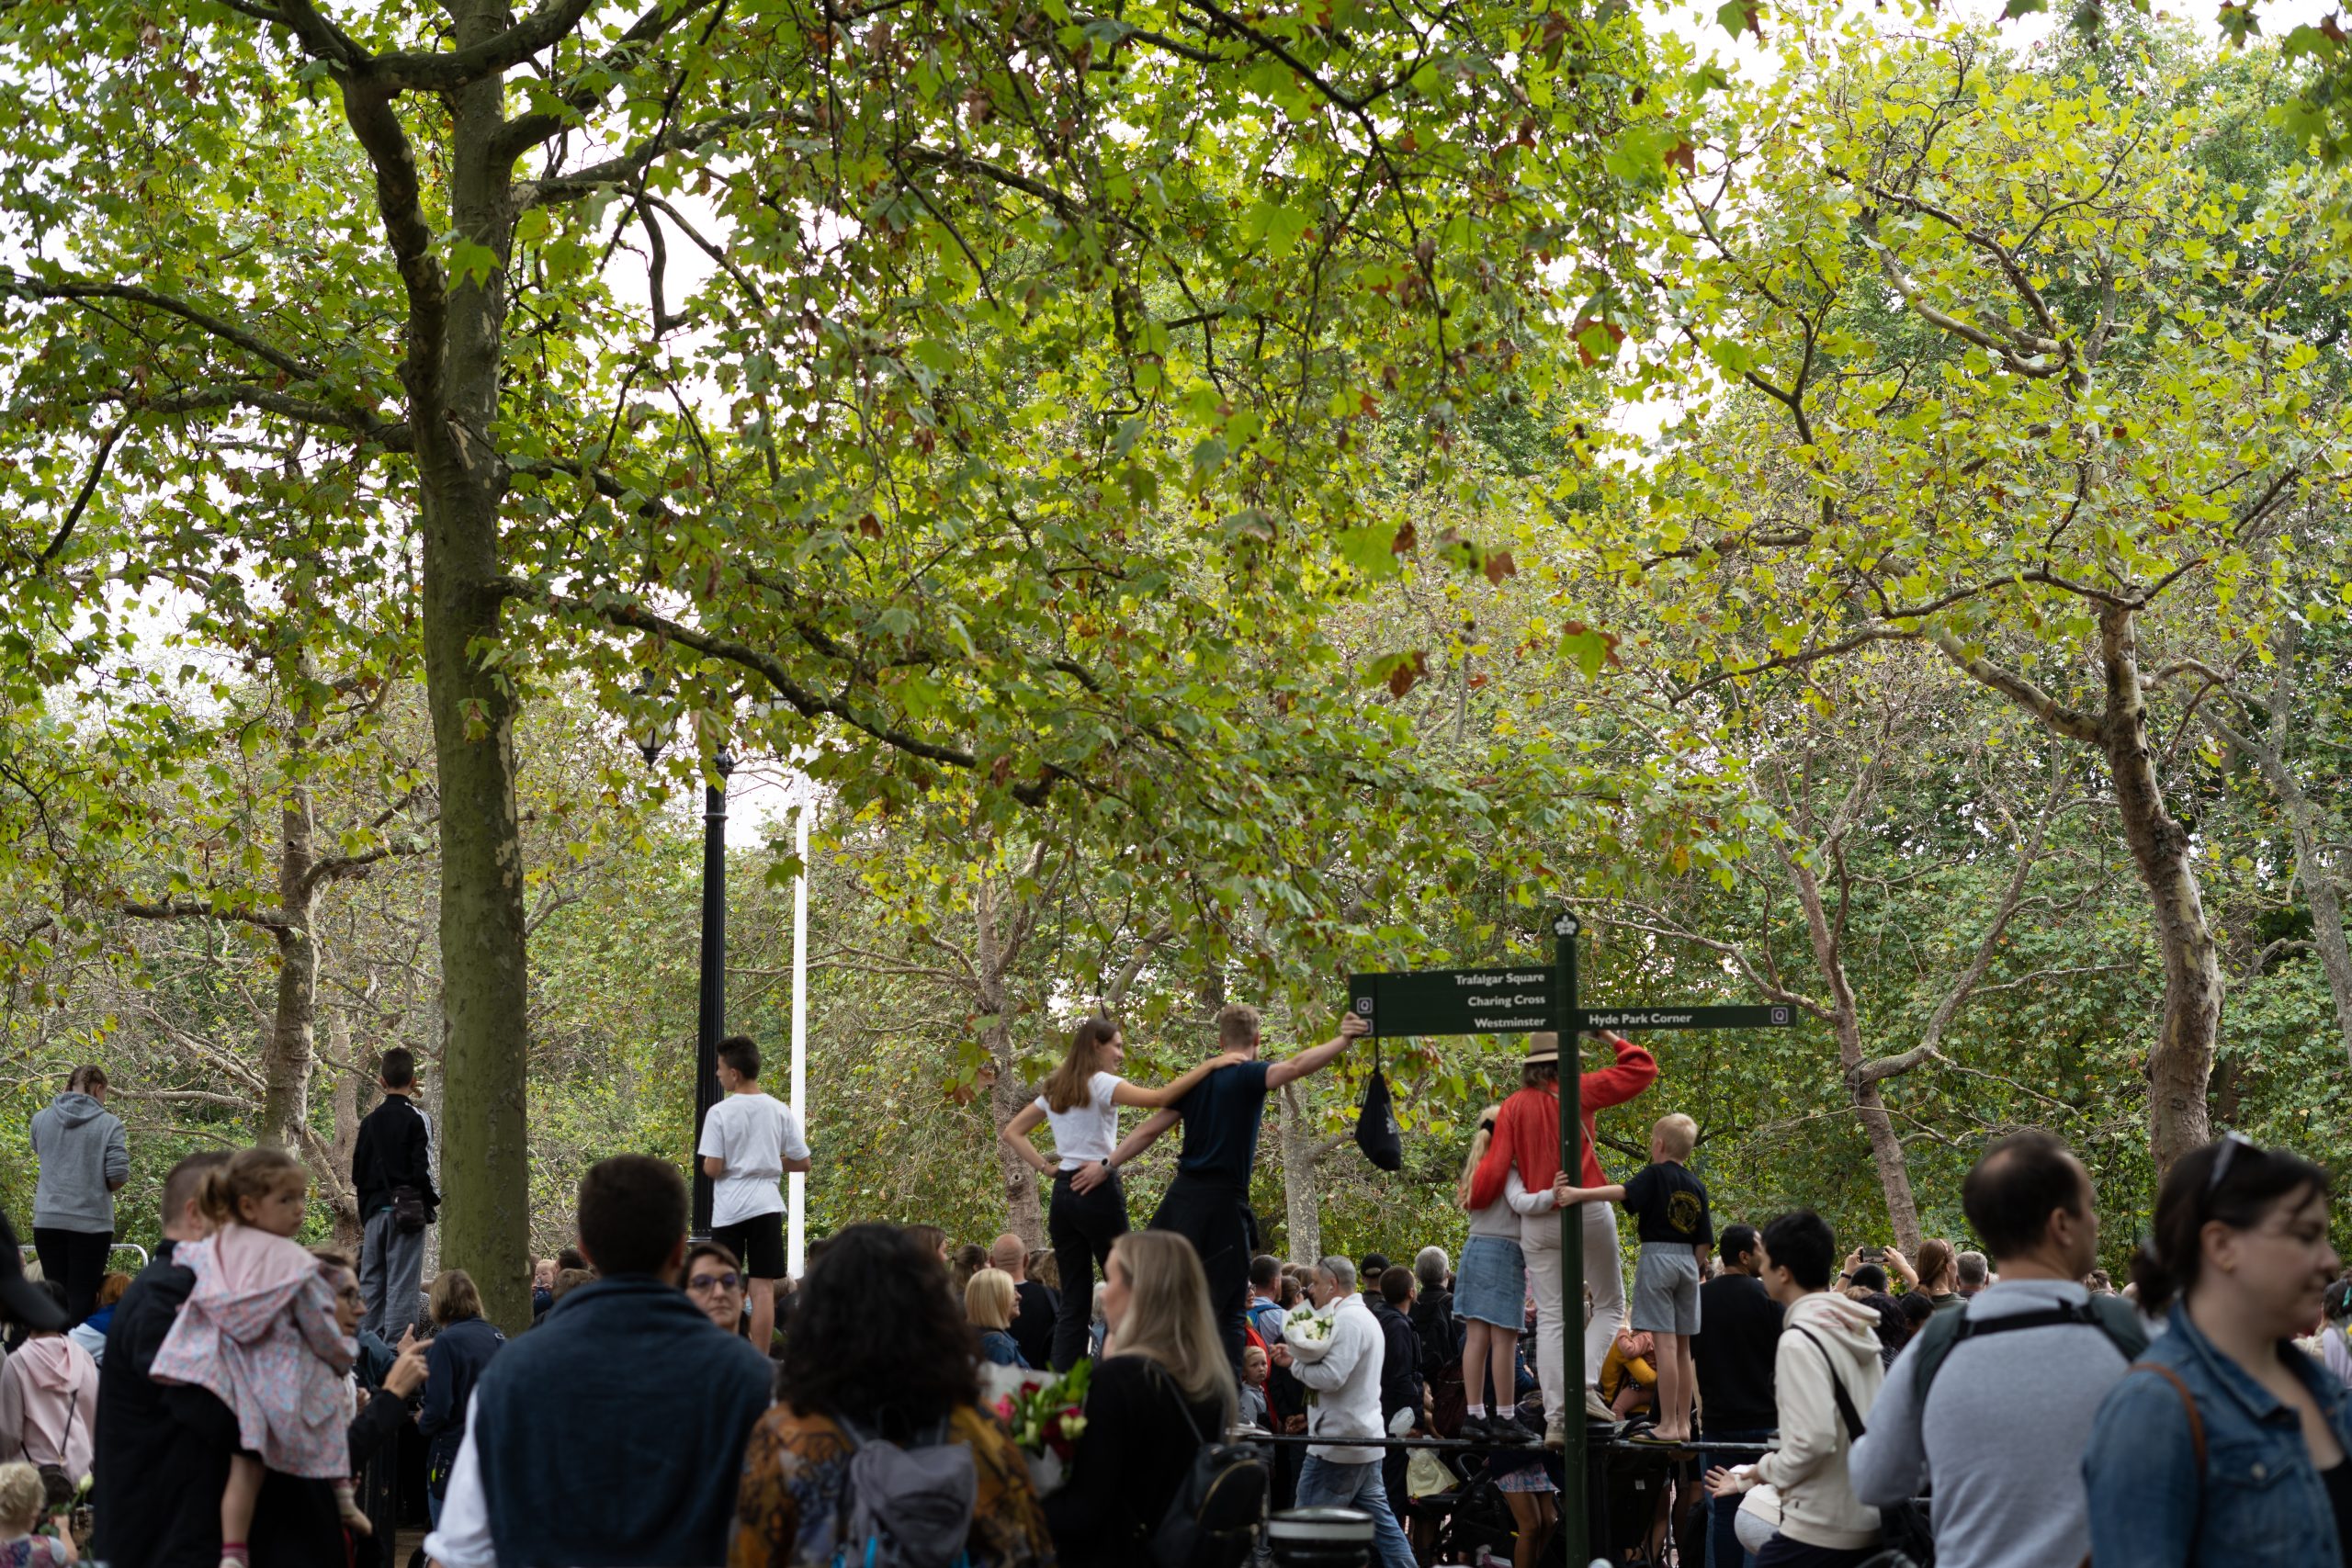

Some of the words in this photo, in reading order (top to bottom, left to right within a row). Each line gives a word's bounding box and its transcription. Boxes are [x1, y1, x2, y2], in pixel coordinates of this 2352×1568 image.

[1454, 975, 1504, 987] Trafalgar
[1506, 973, 1545, 985] Square
[1467, 996, 1512, 1008] Charing
[1514, 995, 1546, 1005] Cross
[1474, 1017, 1546, 1028] Westminster
[1589, 1014, 1619, 1027] Hyde
[1622, 1013, 1648, 1024] Park
[1650, 1013, 1692, 1023] Corner
